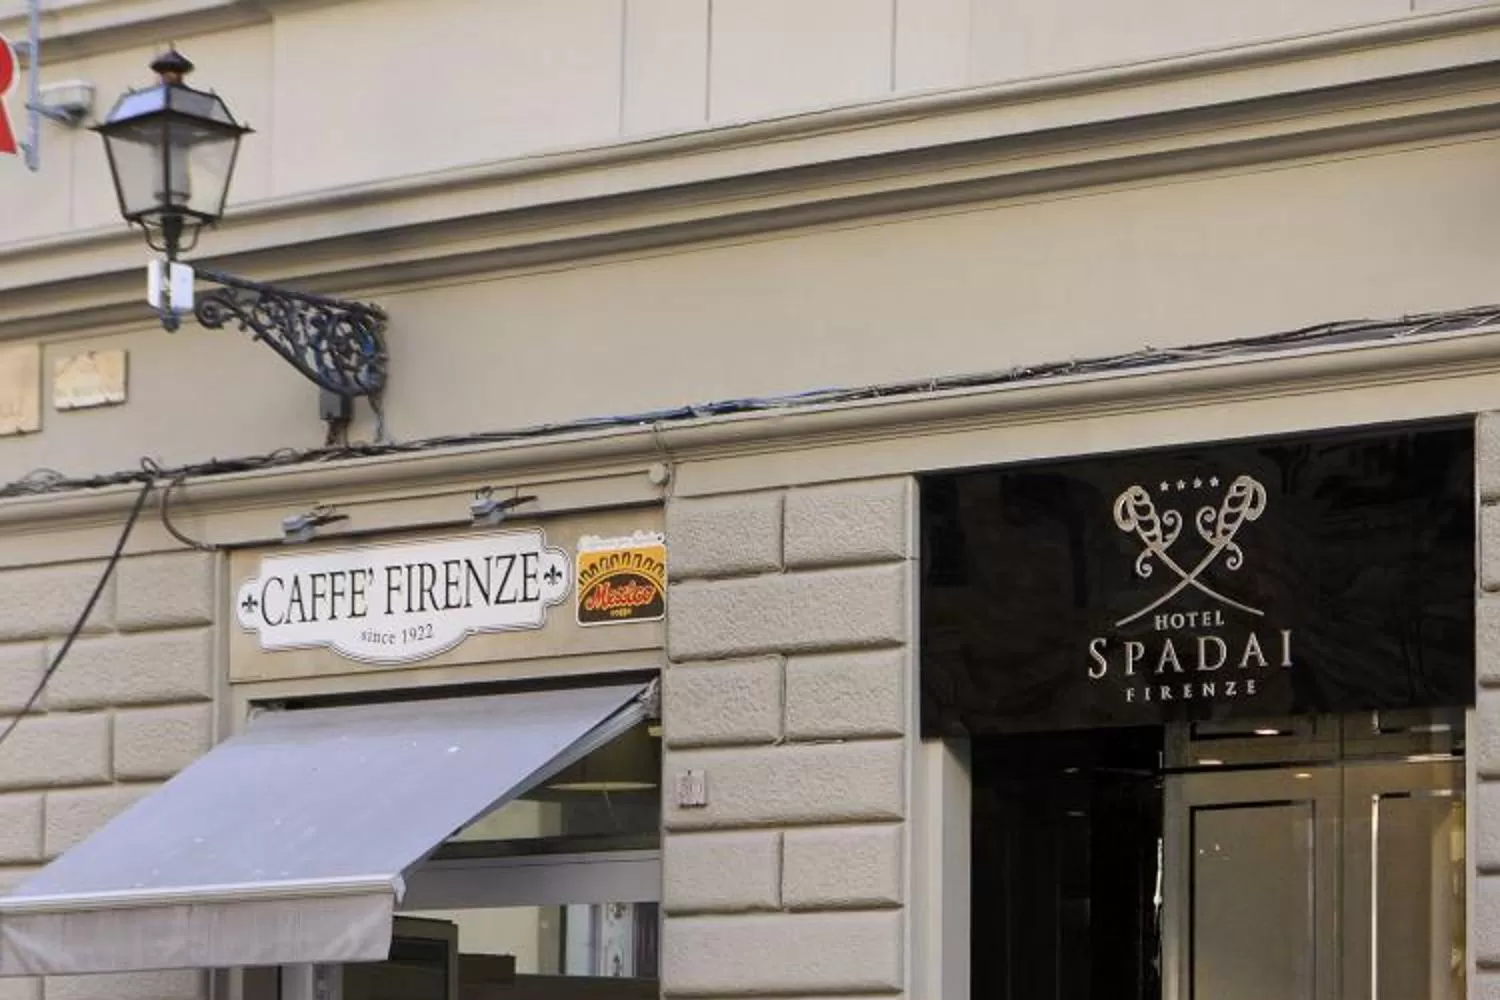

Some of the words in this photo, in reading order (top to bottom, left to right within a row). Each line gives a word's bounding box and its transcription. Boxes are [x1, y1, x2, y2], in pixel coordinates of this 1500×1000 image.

[261, 568, 375, 627] CAFFE'
[383, 551, 541, 615] FIRENZE
[1154, 609, 1225, 630] HOTEL
[360, 628, 396, 645] since
[402, 624, 434, 644] 1922
[1087, 628, 1294, 680] SPADAI
[1126, 679, 1259, 702] FIRENZE
